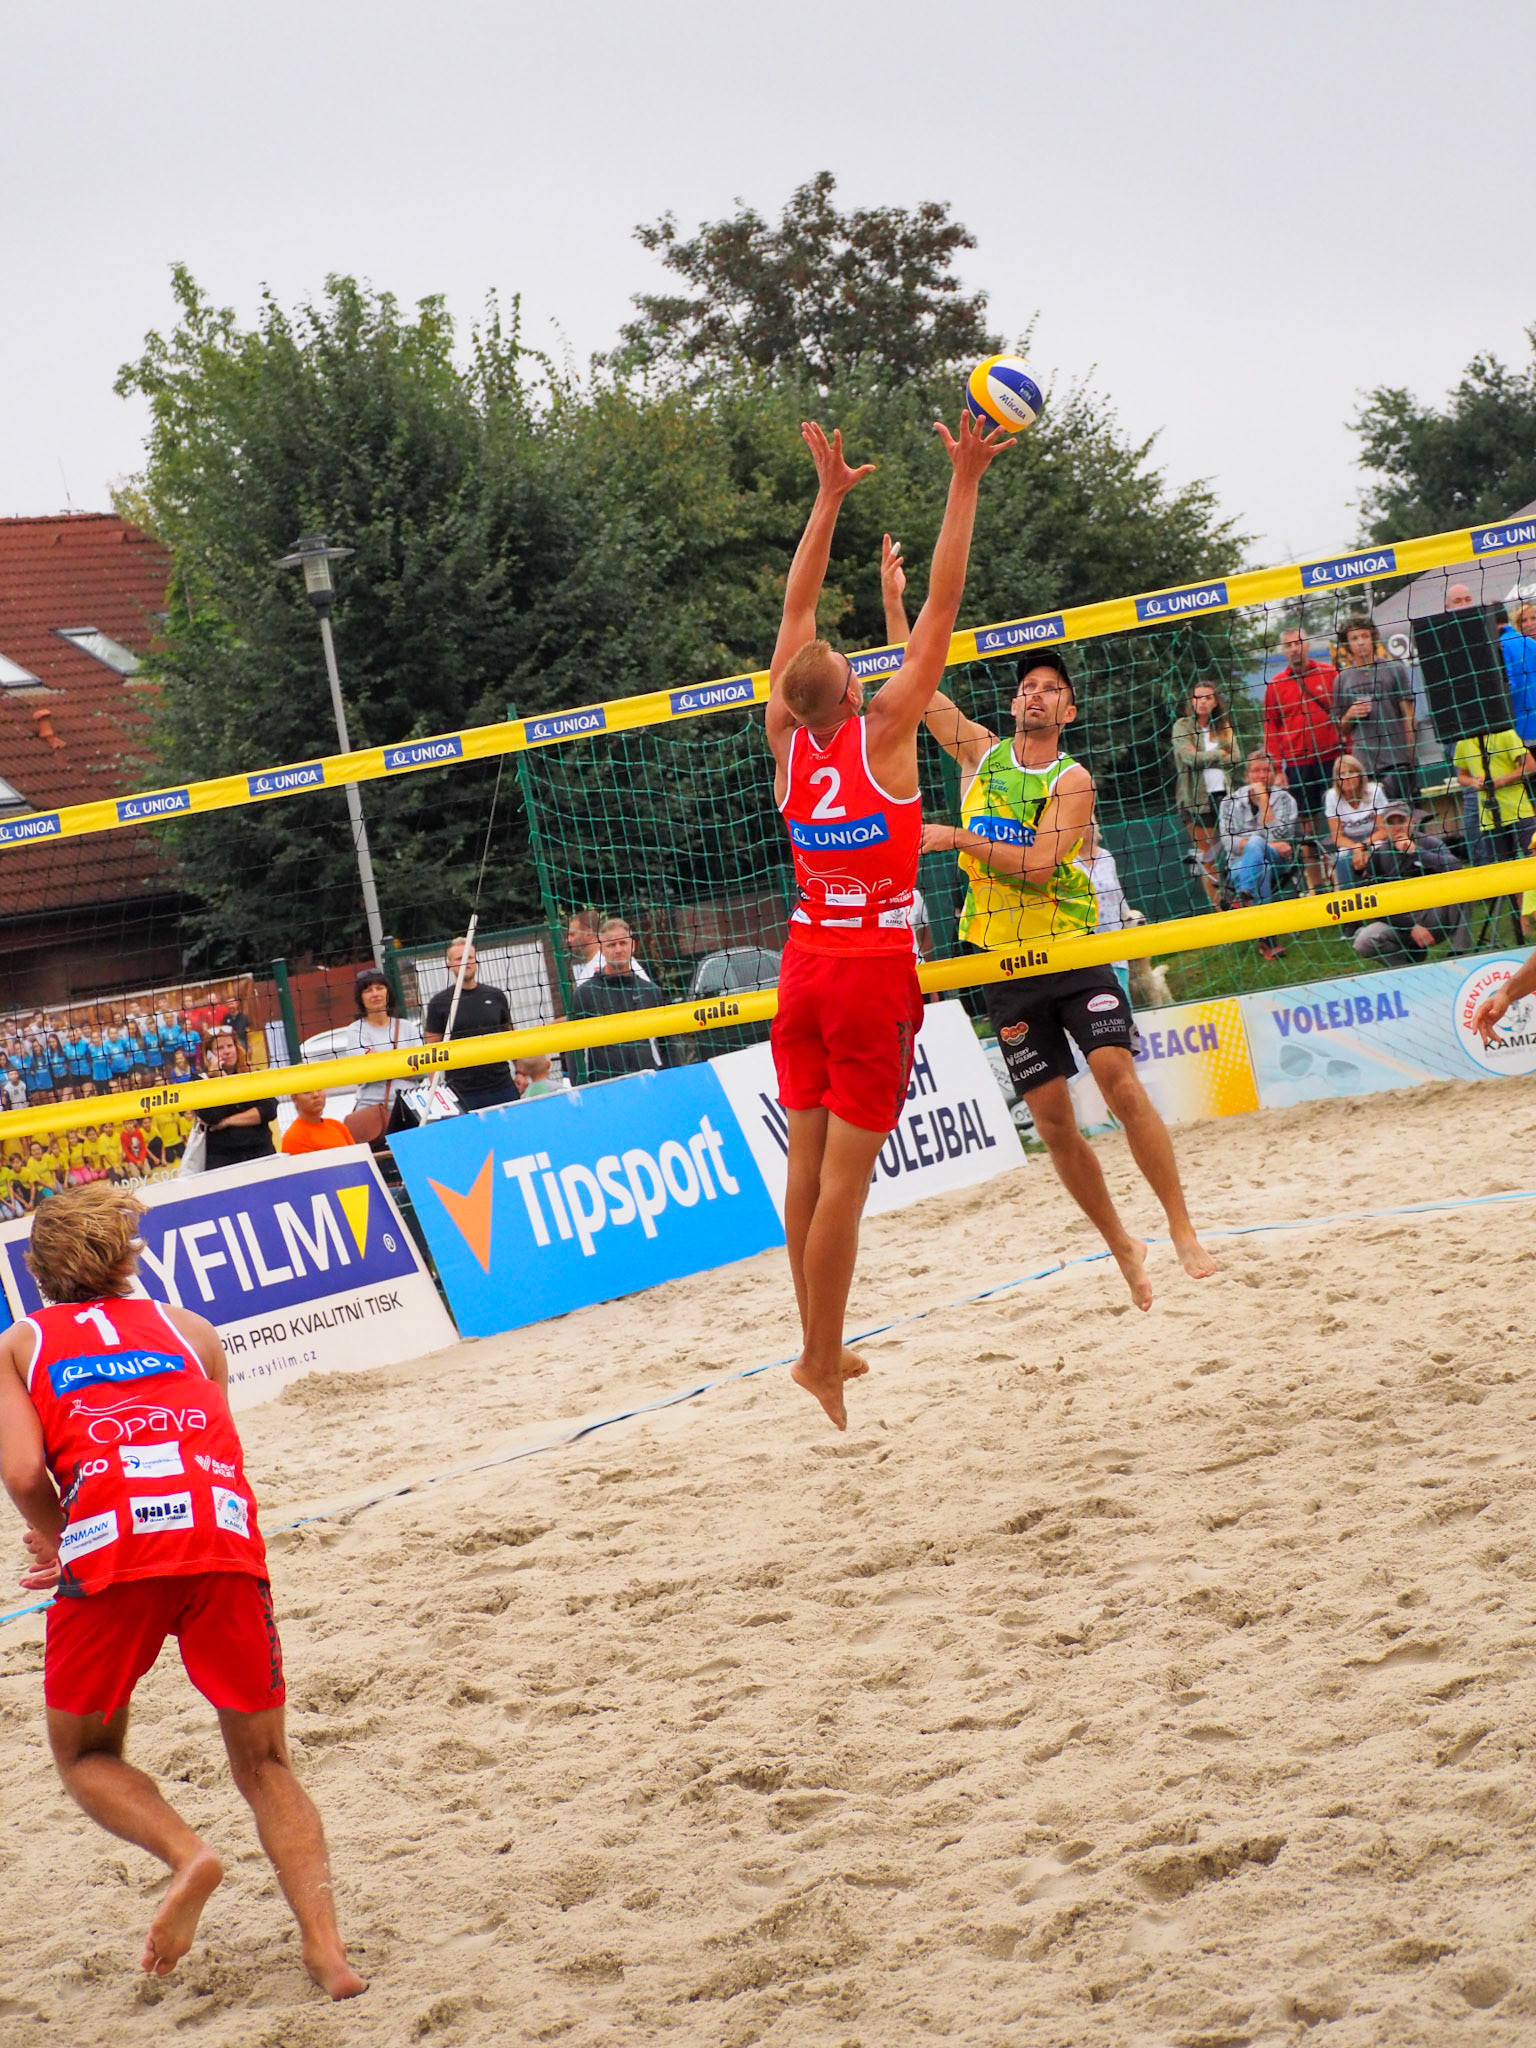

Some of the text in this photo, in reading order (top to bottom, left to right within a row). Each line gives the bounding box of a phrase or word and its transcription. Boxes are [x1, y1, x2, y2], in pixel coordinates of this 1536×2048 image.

[1335, 556, 1389, 578] UNIQA
[1168, 589, 1221, 612] UNIQA
[1006, 622, 1057, 645] UNIQA
[852, 655, 900, 675] UNIQA
[700, 684, 749, 706] UNIQA
[553, 713, 600, 735] UNIQA
[412, 742, 457, 763] UNIQA
[274, 769, 318, 789] UNIQA
[809, 766, 846, 819] 2
[143, 795, 185, 815] UNIQA
[15, 820, 56, 837] UNIQA
[815, 824, 884, 845] UNIQA
[1326, 892, 1378, 920] gala
[1000, 950, 1048, 976] gala
[1463, 971, 1512, 1030] AGENTURA
[694, 999, 740, 1026] gala
[1273, 989, 1409, 1037] VOLEJBAL
[1133, 1022, 1219, 1062] BEACH
[407, 1047, 449, 1072] gala
[1020, 1061, 1048, 1079] UNIQA
[140, 1090, 179, 1113] gala
[503, 1115, 740, 1257] Tipsport
[126, 1193, 351, 1309] YFILM
[75, 1307, 120, 1345] 1
[250, 1323, 287, 1349] PRO
[289, 1297, 364, 1338] KVALITNÍ
[365, 1291, 403, 1316] TISK
[135, 1503, 186, 1522] gala
